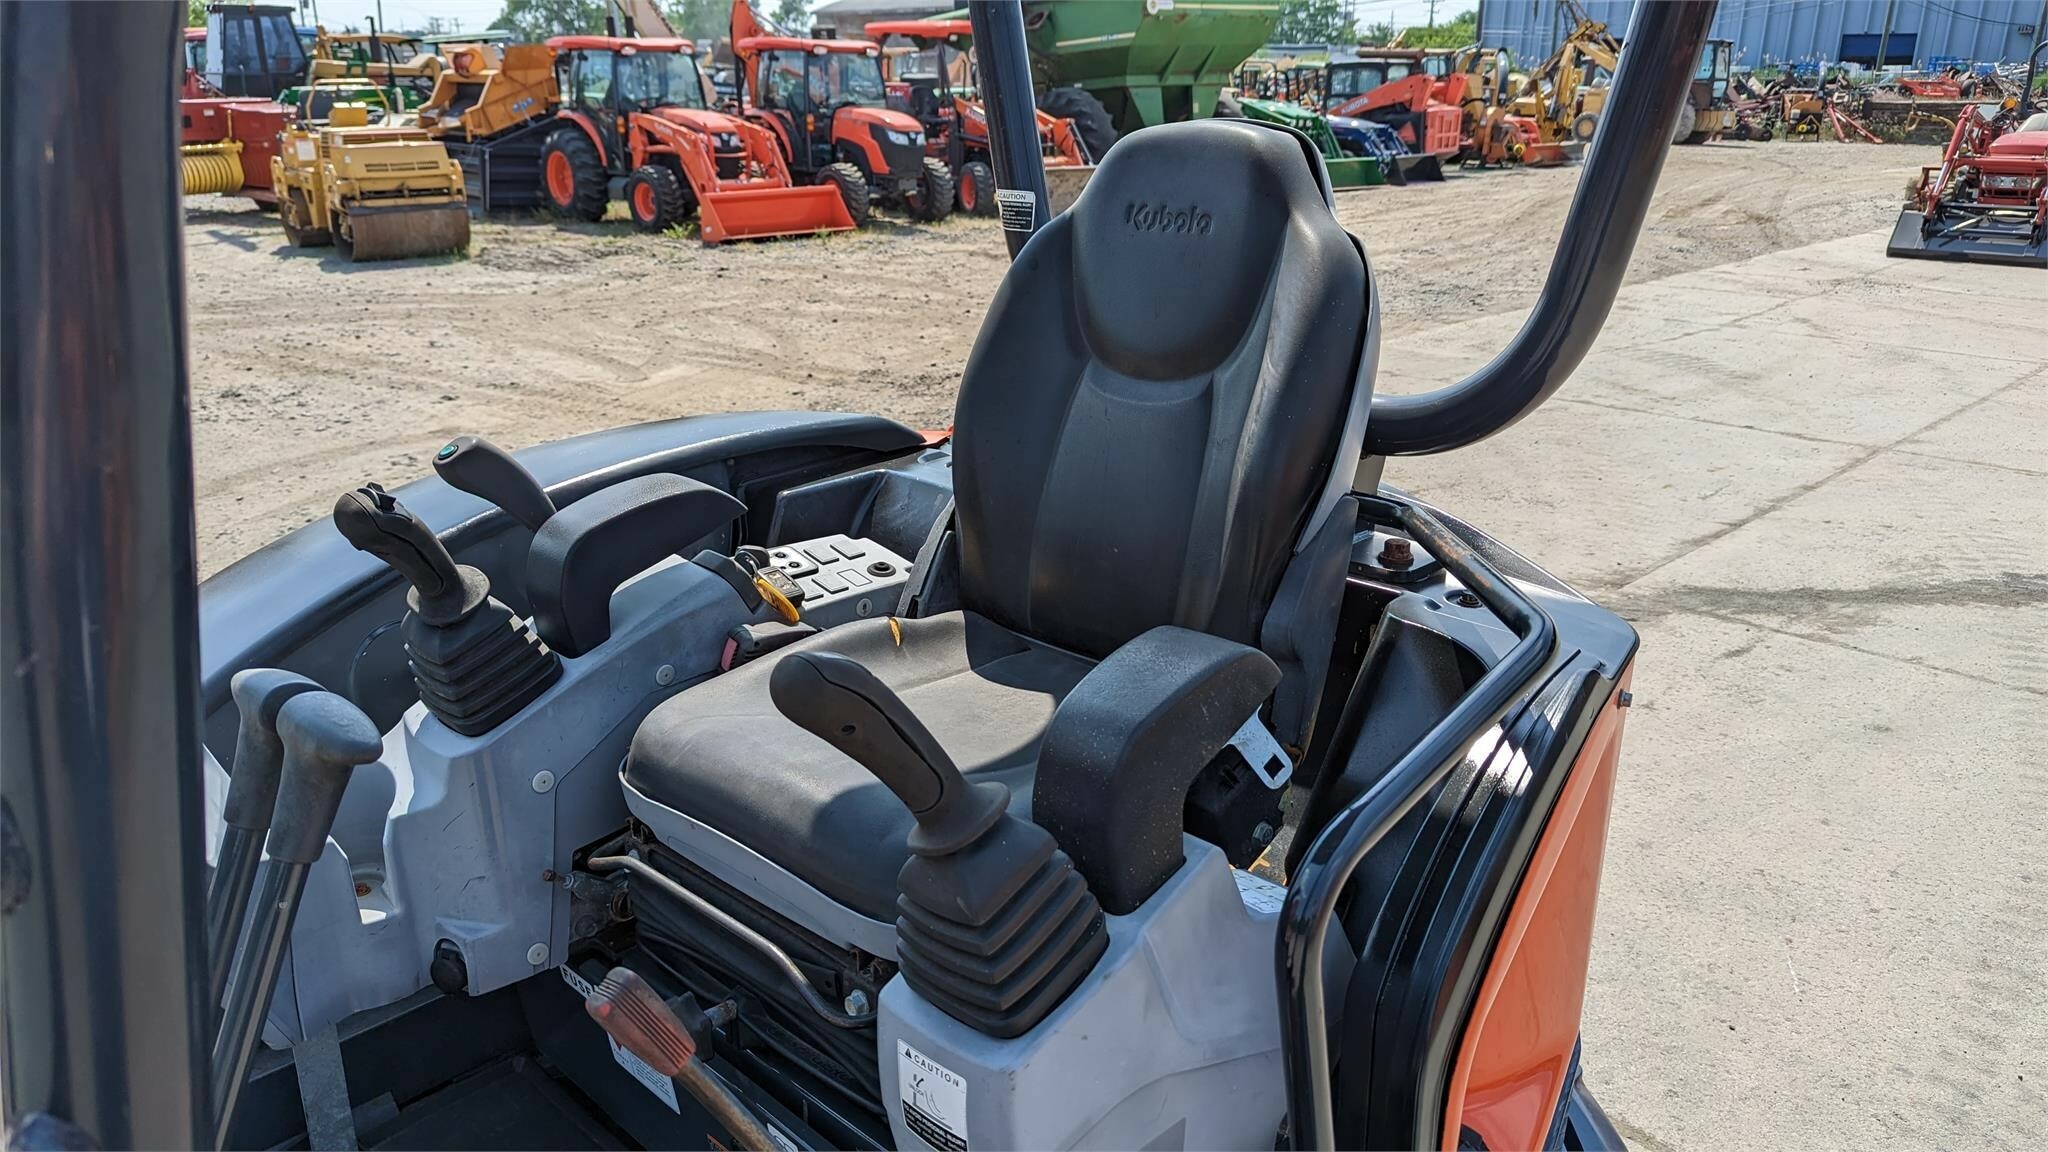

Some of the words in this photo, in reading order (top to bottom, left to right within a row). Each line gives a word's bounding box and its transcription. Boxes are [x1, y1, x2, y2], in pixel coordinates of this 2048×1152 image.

[1341, 97, 1368, 114] KUBOTA
[999, 192, 1026, 200] CAUTION
[914, 1055, 959, 1087] CAUTION
